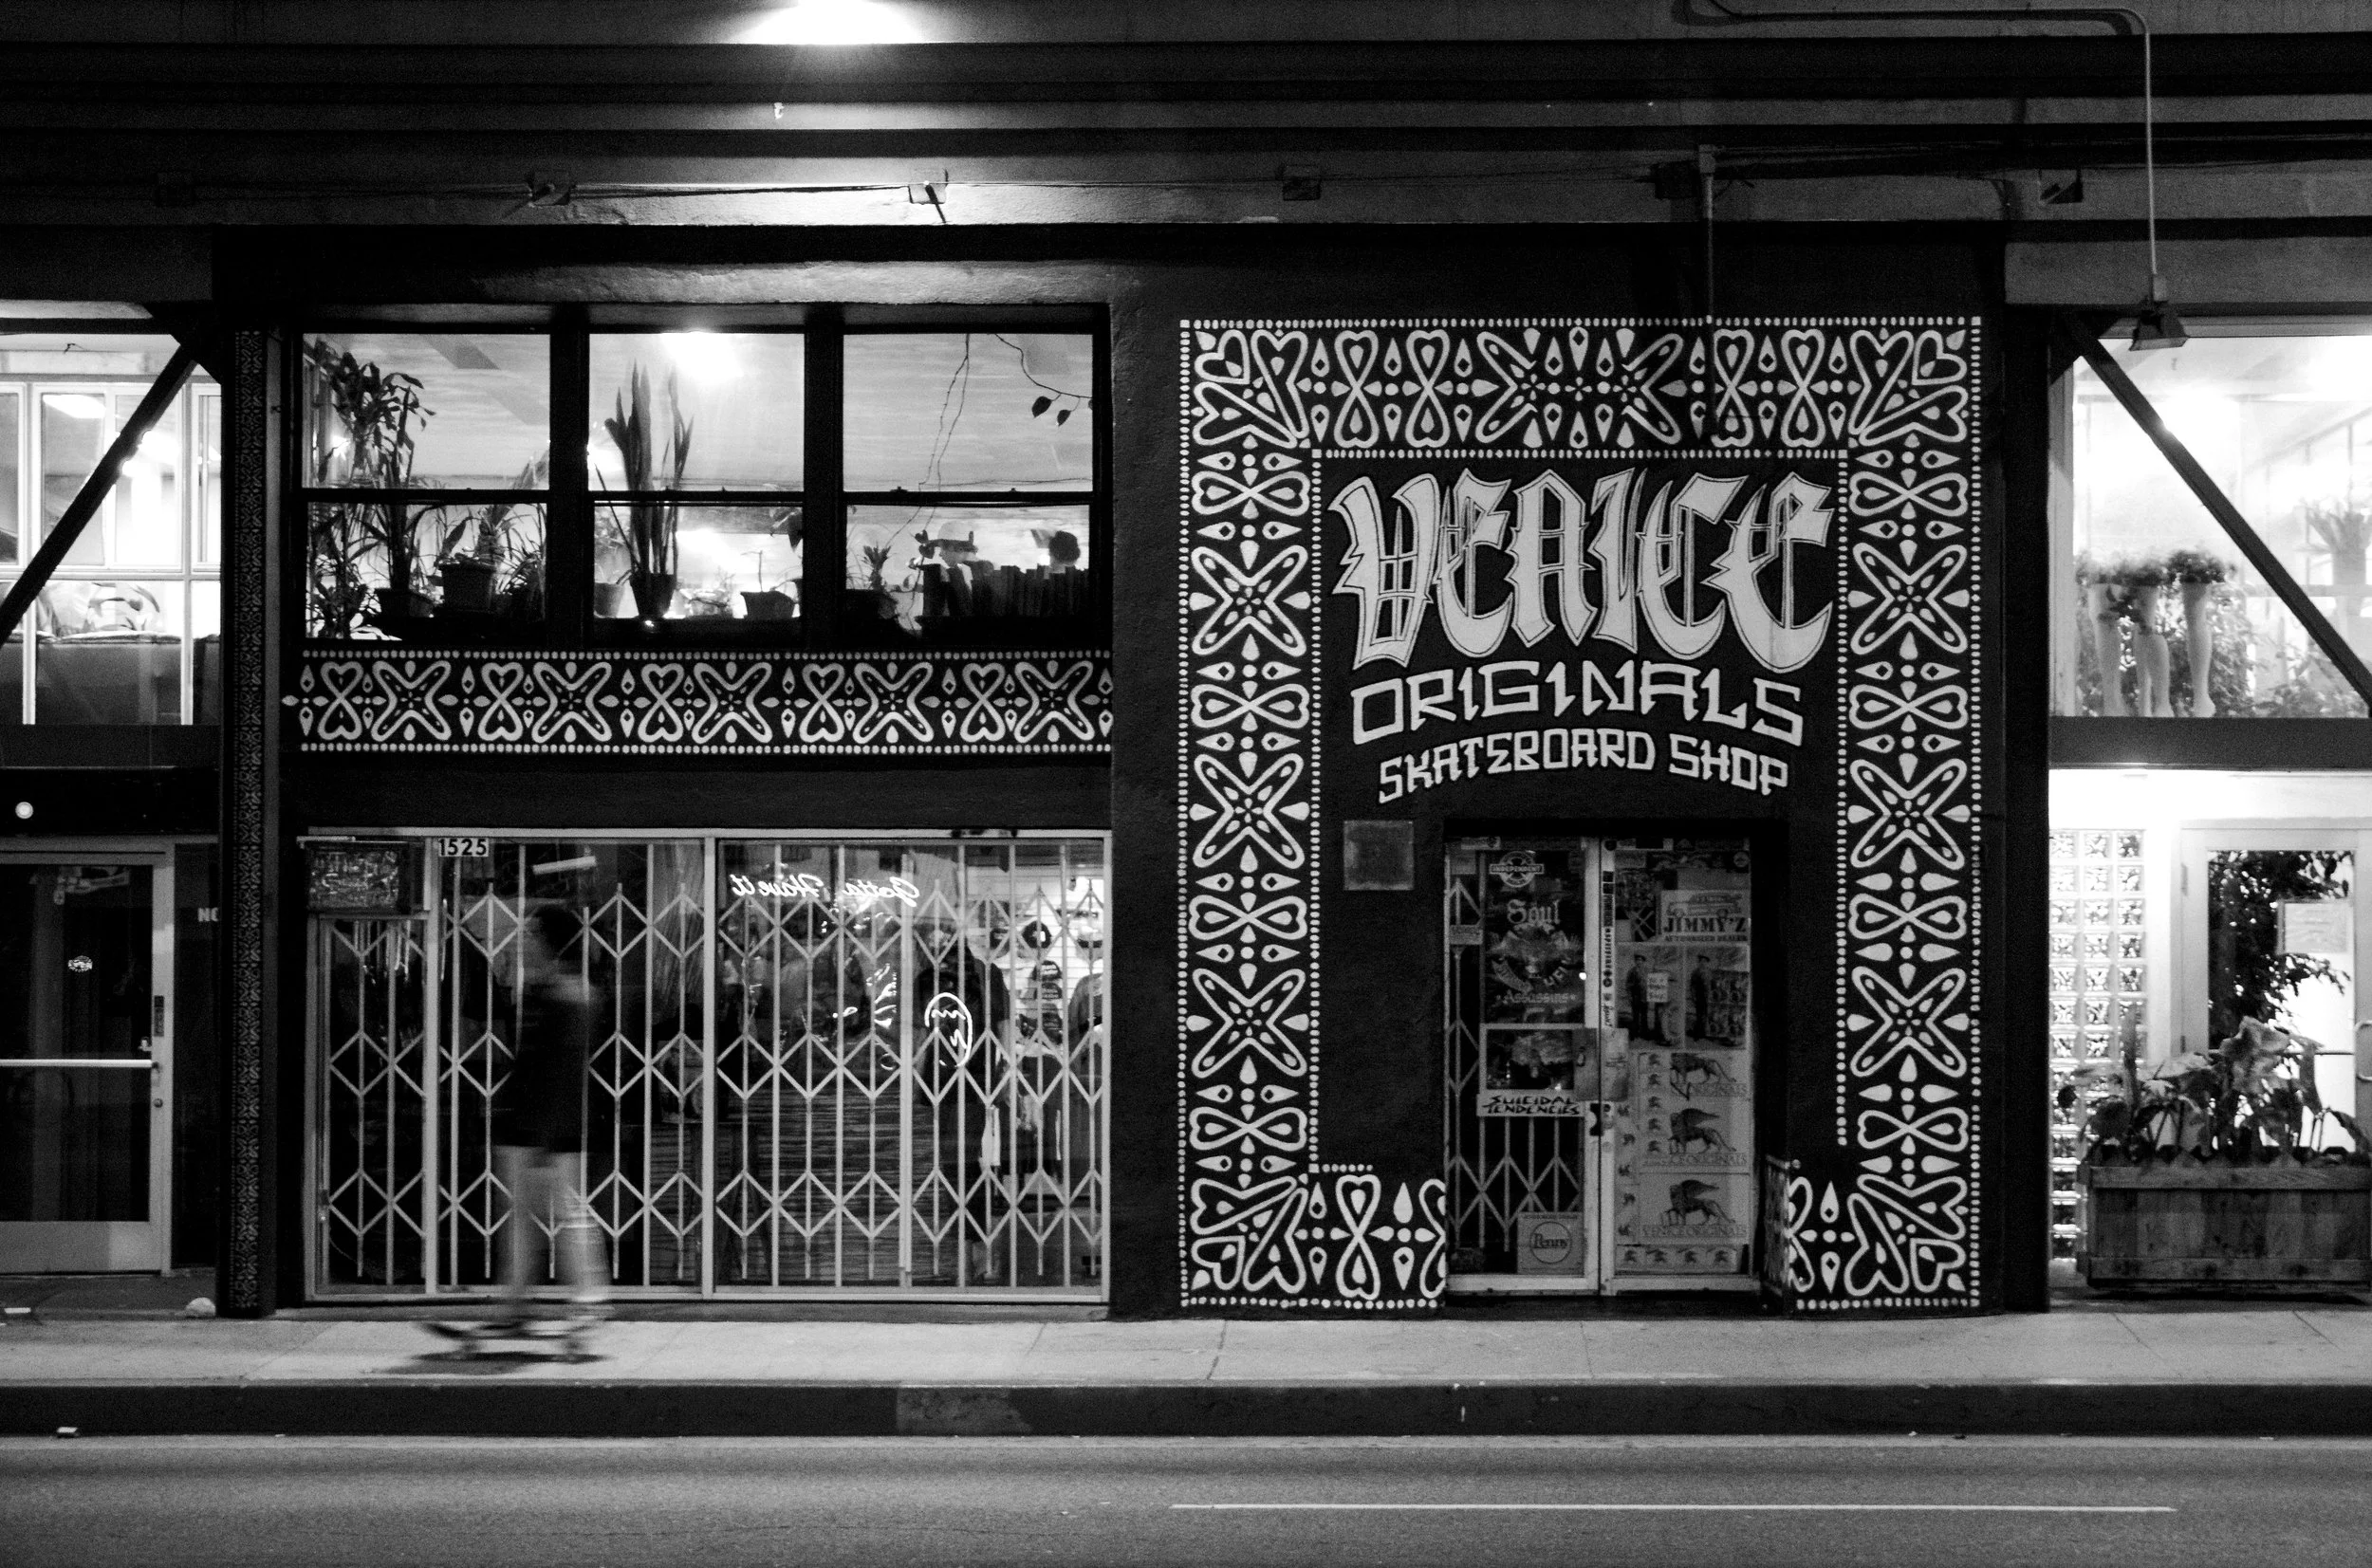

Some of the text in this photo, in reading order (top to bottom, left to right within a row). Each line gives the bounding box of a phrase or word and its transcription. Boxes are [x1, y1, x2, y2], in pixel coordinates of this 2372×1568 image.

[1327, 468, 1834, 673] VENICE
[1351, 660, 1803, 746] ORIGINALS
[1379, 729, 1788, 803] SKATEBOARD SHOP
[438, 839, 487, 856] 1525
[1506, 898, 1561, 925] Soul
[1663, 917, 1747, 932] JIMMY'Z
[1481, 1103, 1581, 1116] TENDENCIES
[1488, 1095, 1576, 1106] SUICIDAL
